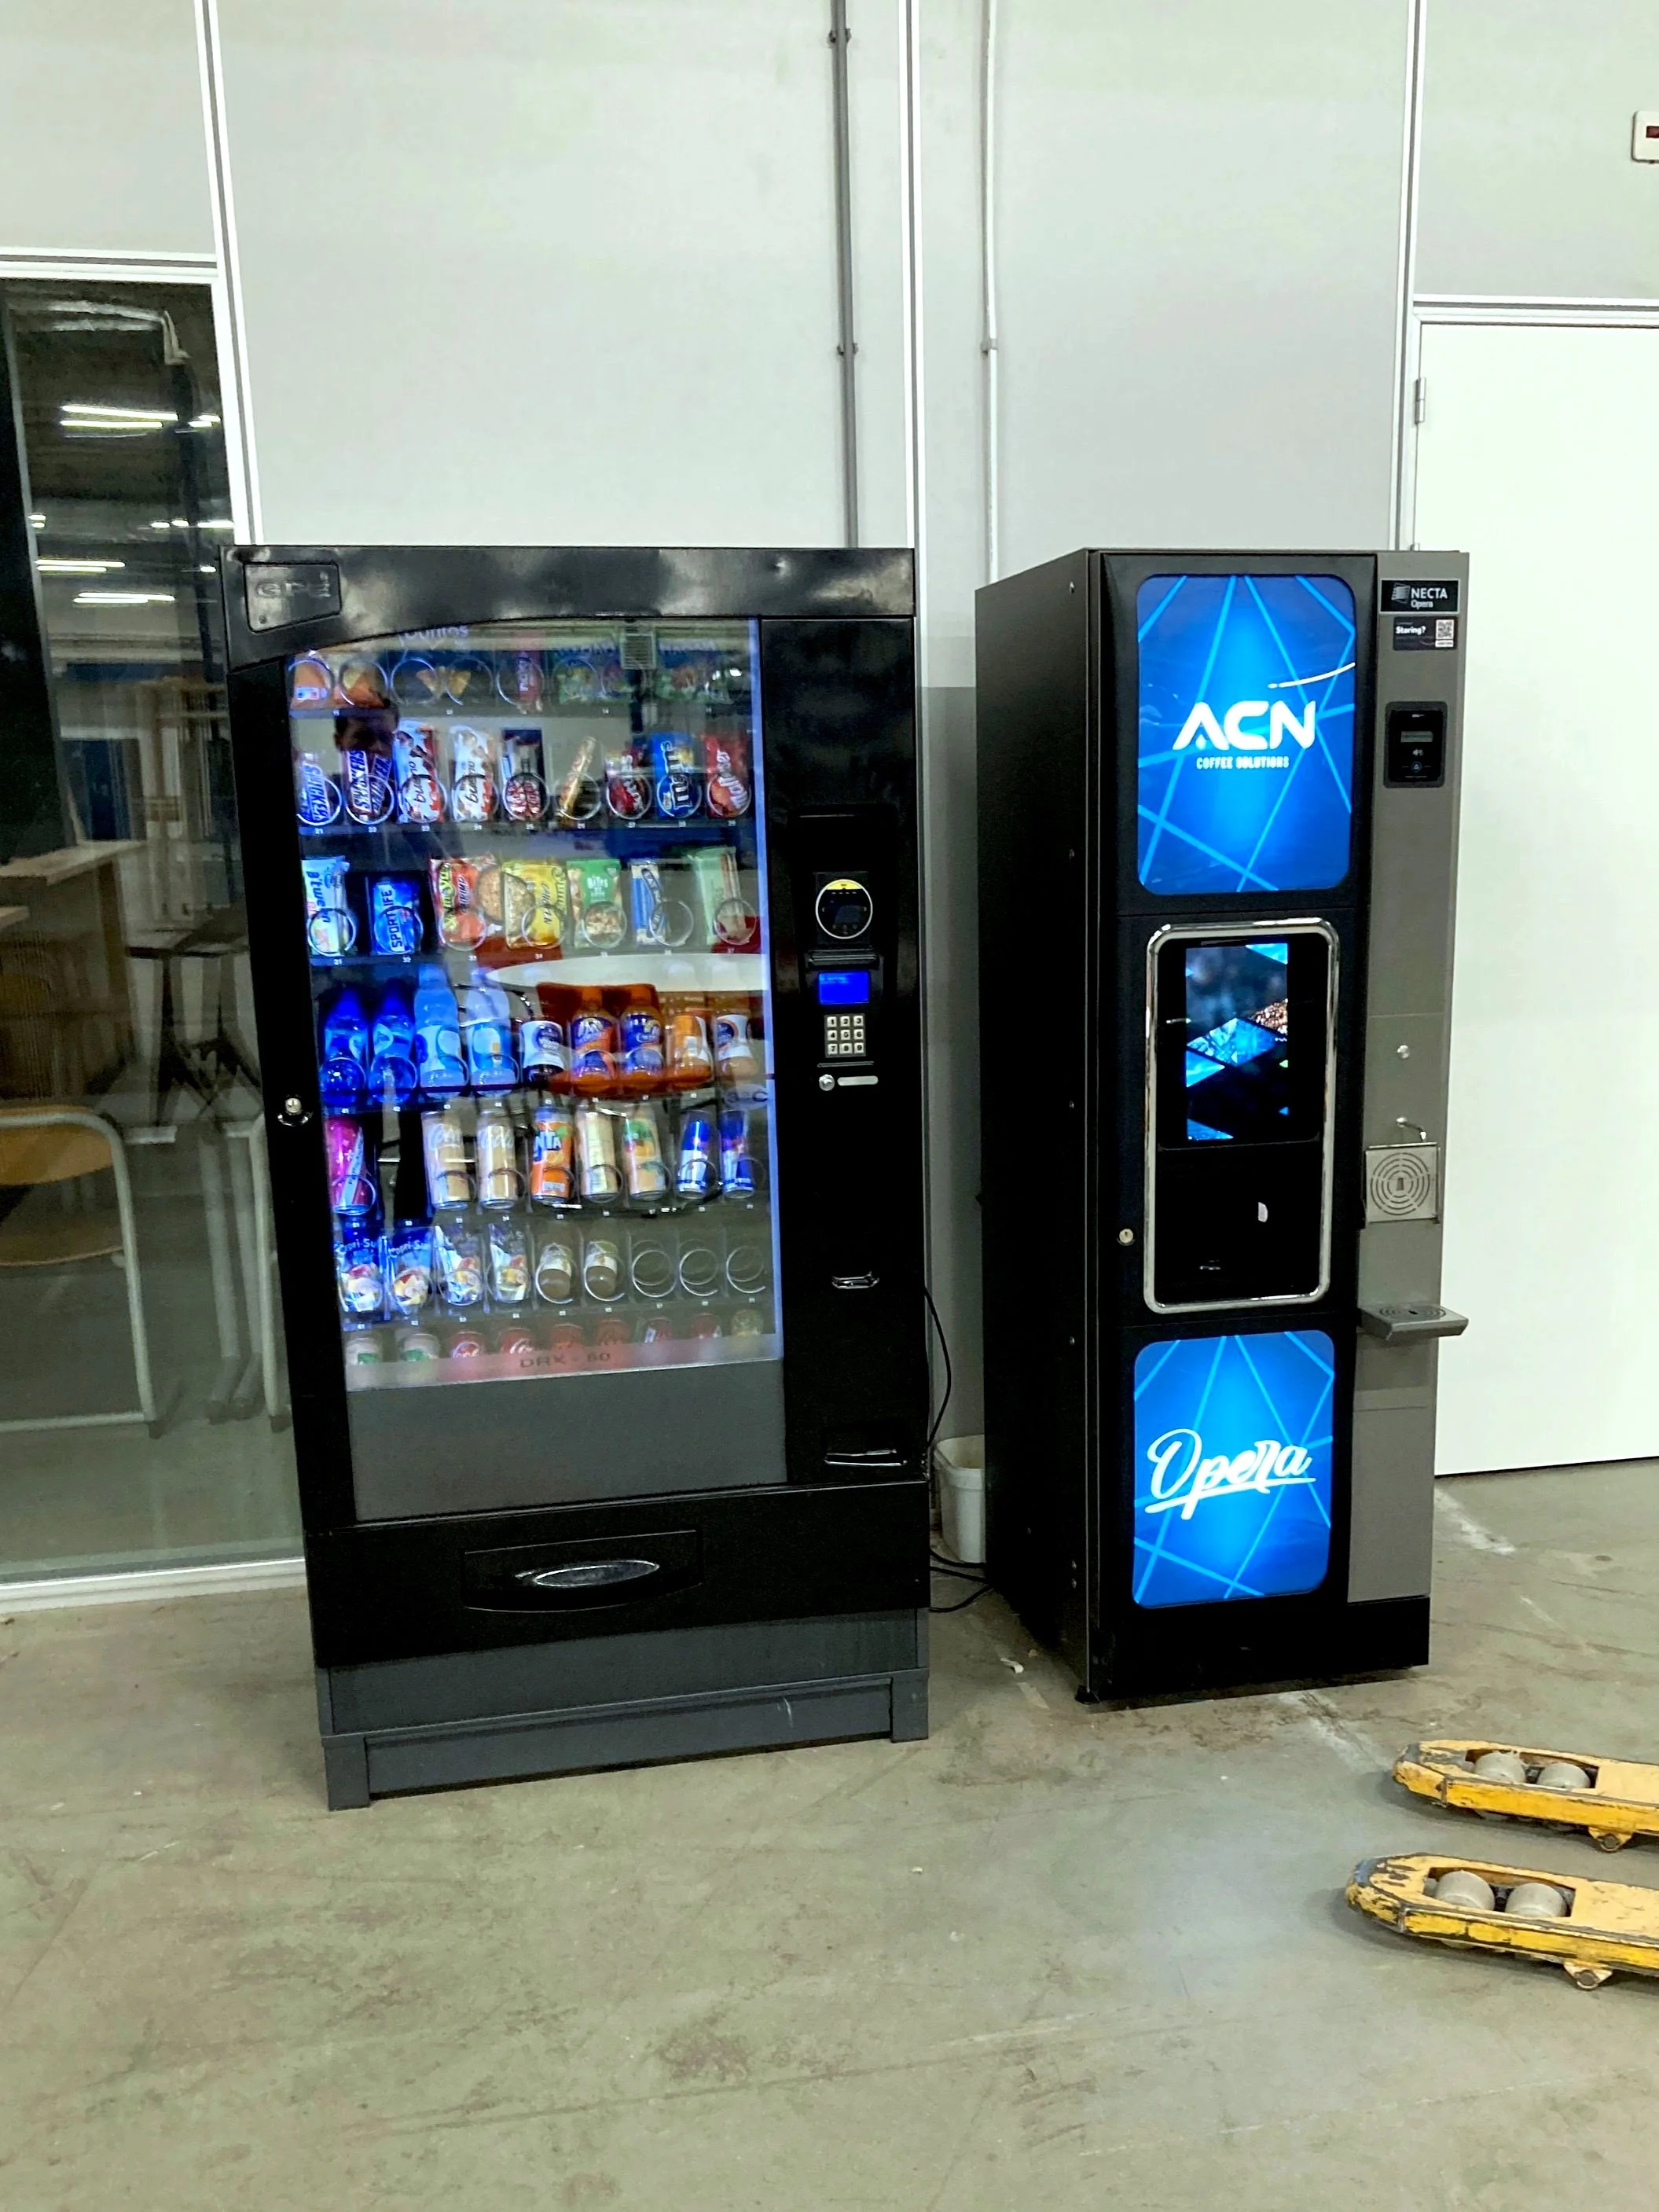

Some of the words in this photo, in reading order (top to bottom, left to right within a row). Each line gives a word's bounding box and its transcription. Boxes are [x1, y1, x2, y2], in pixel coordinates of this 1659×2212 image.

[1411, 587, 1448, 599] NECTA
[1396, 626, 1426, 636] Storing?
[1172, 700, 1316, 751] ACN
[1196, 757, 1233, 770] COFFEE
[1235, 755, 1290, 770] SOLUTIONS
[1144, 1428, 1316, 1520] Opera
